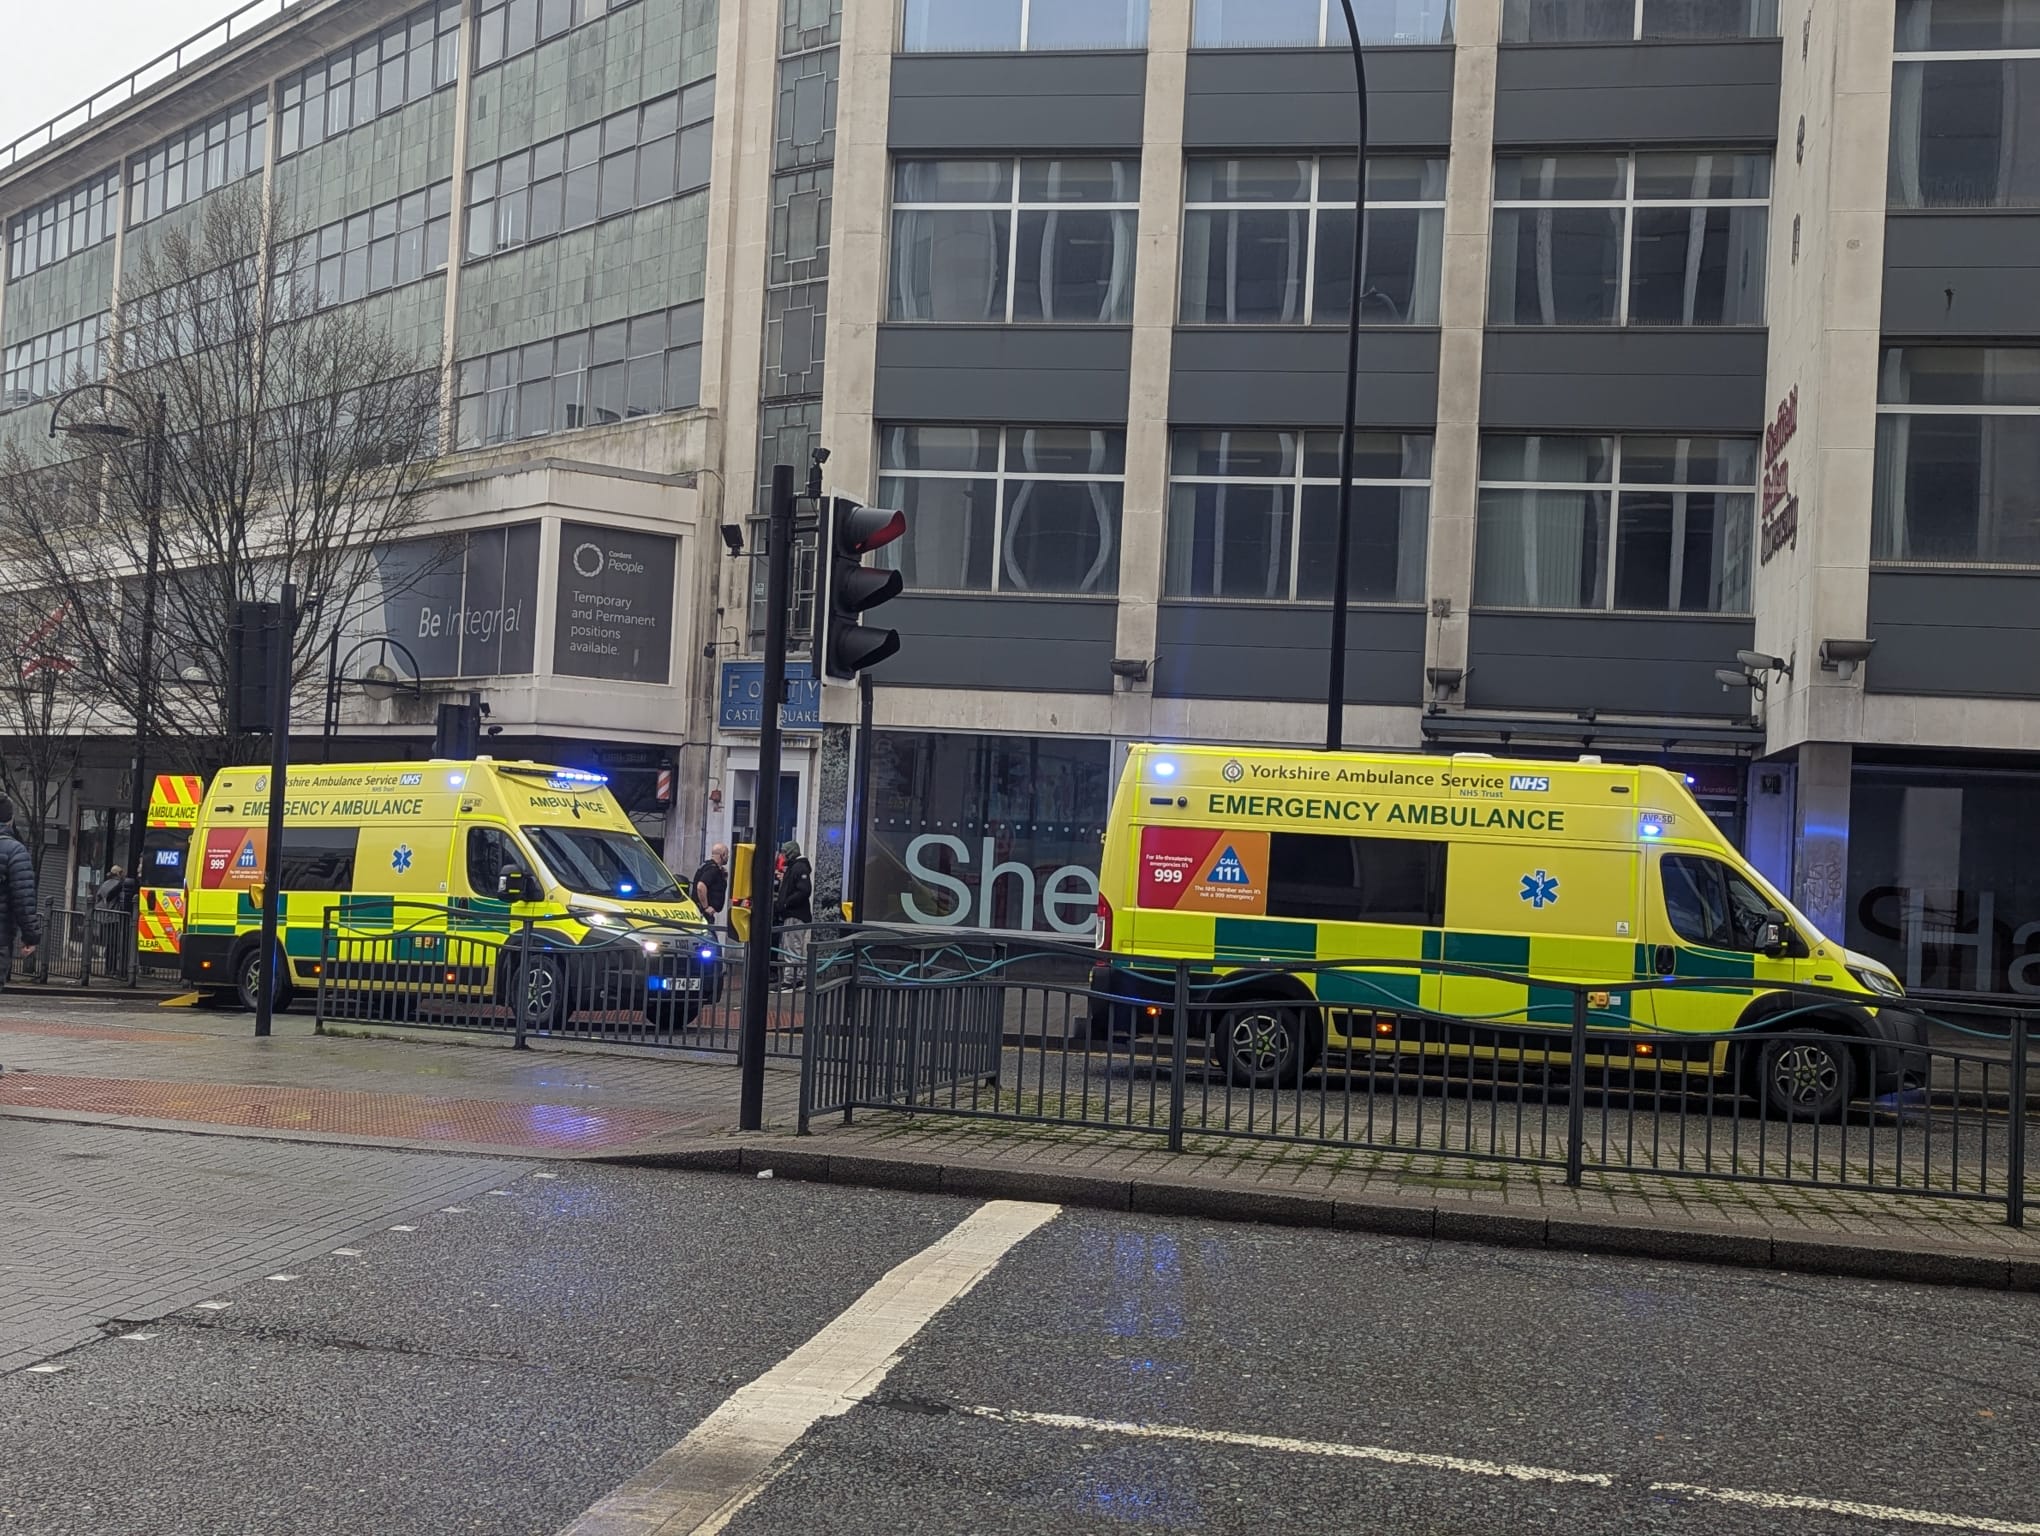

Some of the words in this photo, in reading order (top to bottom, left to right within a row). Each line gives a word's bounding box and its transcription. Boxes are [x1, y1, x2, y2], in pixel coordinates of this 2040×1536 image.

[608, 558, 644, 574] People
[572, 590, 632, 610] Temporary
[418, 606, 441, 639] Be
[445, 598, 522, 642] Integral
[571, 608, 593, 620] and
[595, 609, 656, 627] Permanent
[570, 624, 621, 640] positions
[569, 641, 620, 656] available.
[728, 674, 818, 699] FOTY
[725, 708, 760, 721] CASTL
[780, 709, 818, 723] QUARE
[285, 776, 310, 787] kshire
[312, 775, 363, 787] Ambulance
[365, 774, 398, 786] Service
[401, 774, 422, 785] NHS
[1250, 764, 1330, 782] Yorkshire
[1336, 767, 1434, 787] Ambulance
[1441, 772, 1504, 789] Service
[1510, 776, 1549, 791] NHS
[1459, 788, 1479, 797] NHS
[1481, 789, 1504, 798] Trust
[150, 805, 196, 819] AMBULANCE
[242, 800, 330, 816] EMEGENCY
[330, 799, 424, 815] AMBULANCE
[530, 796, 606, 814] AMBULANCE
[1208, 793, 1381, 822] EMERGENCY
[1386, 803, 1564, 831] AMBULANCE
[156, 851, 180, 866] NHS
[210, 858, 225, 870] 999
[241, 854, 254, 866] 111
[1154, 868, 1183, 883] 999
[1215, 866, 1241, 881] 111
[900, 833, 1099, 935] She
